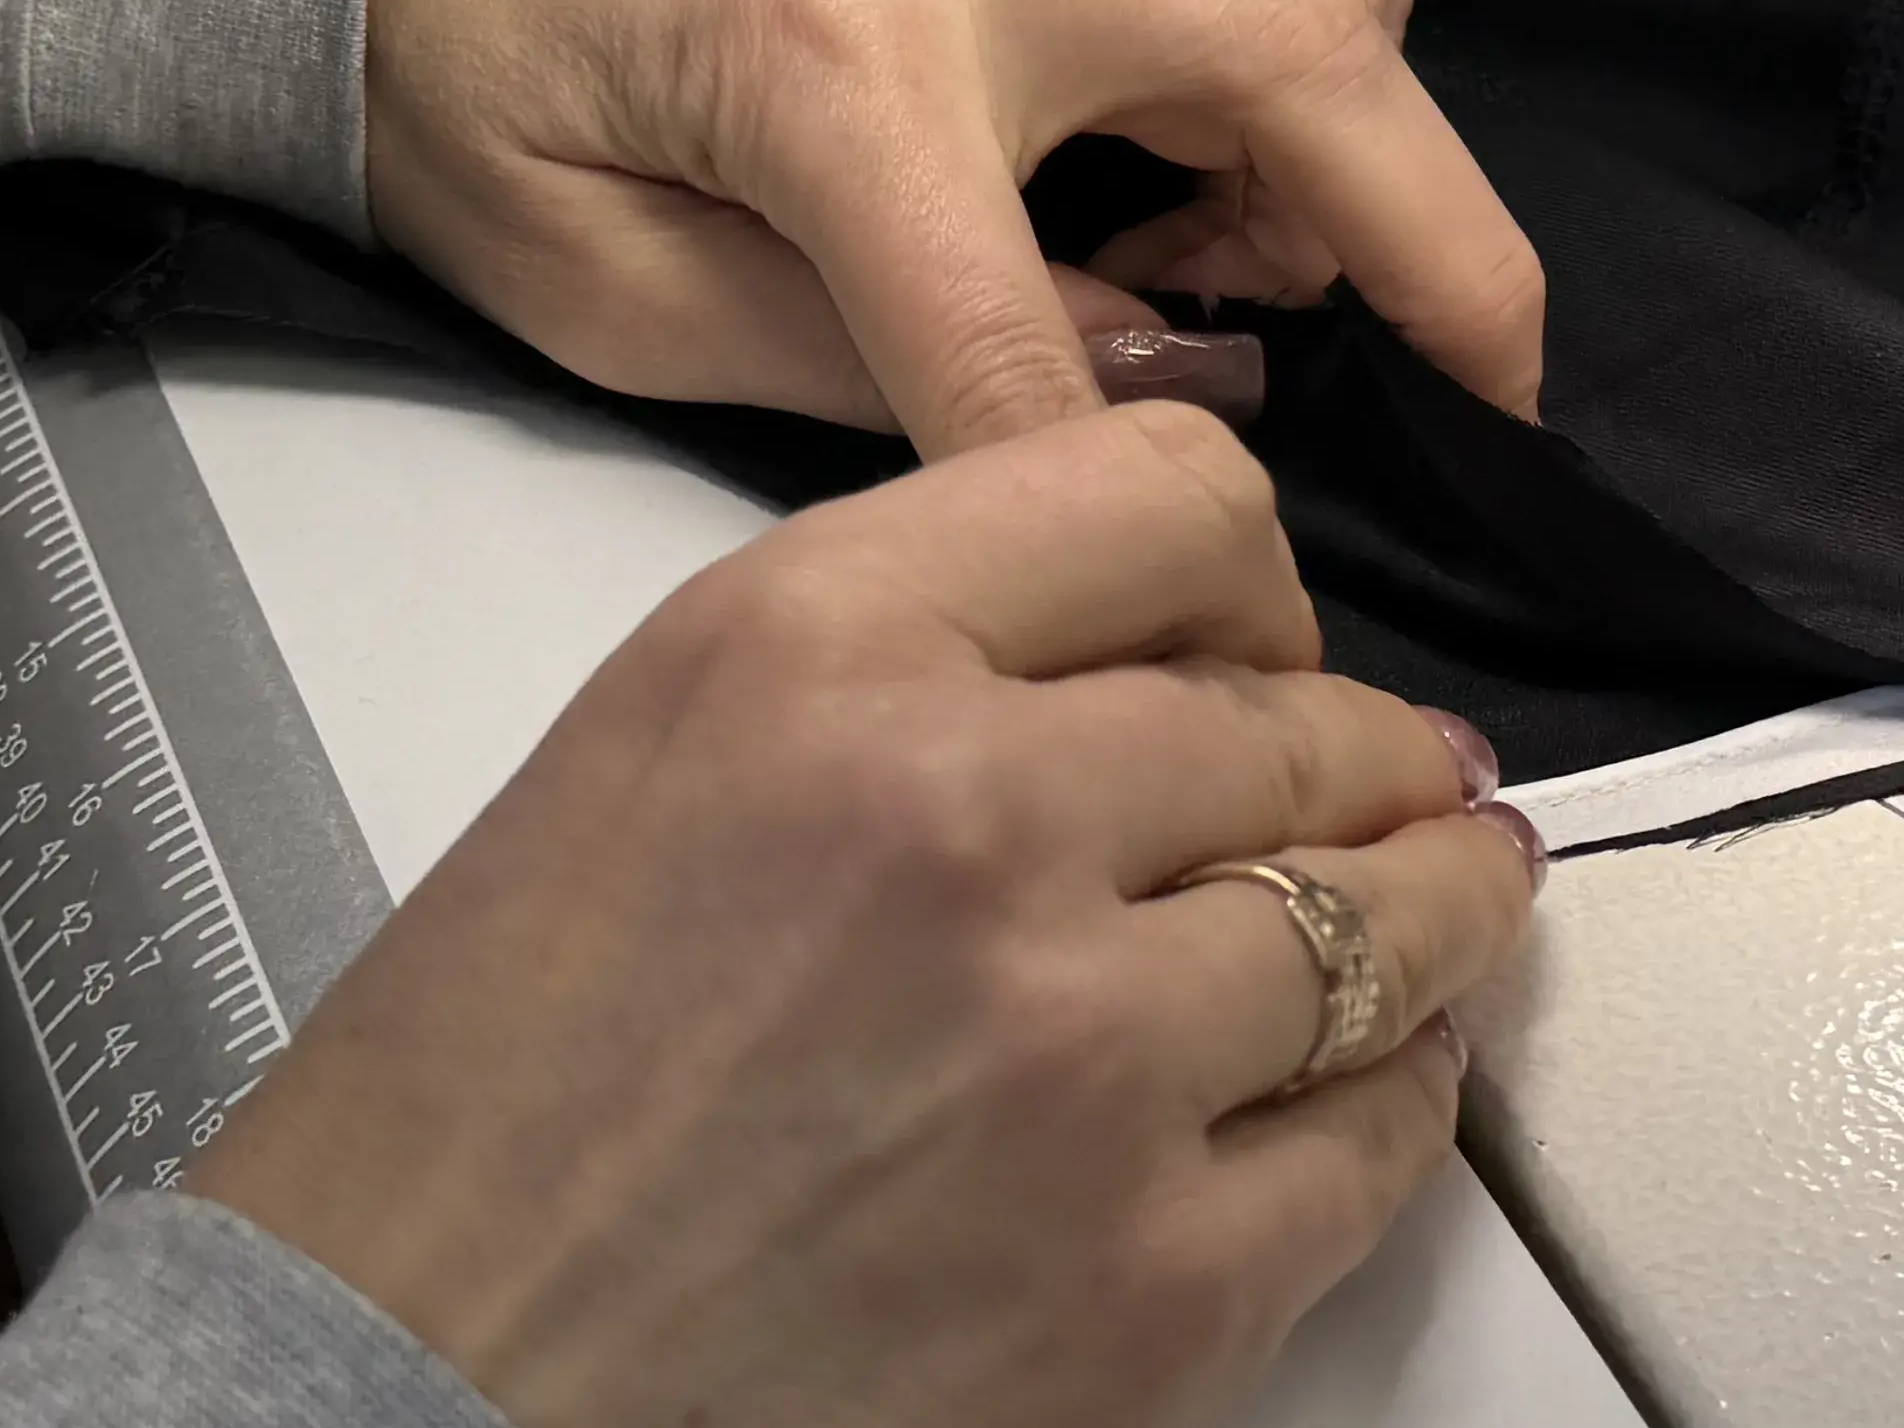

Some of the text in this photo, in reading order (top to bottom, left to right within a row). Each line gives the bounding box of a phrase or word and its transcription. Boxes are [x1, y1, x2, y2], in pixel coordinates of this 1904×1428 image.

[13, 641, 48, 683] 15
[16, 781, 47, 824] 40
[68, 782, 102, 827] 16
[37, 838, 71, 881] 41
[60, 900, 94, 946] 42
[124, 934, 162, 977] 17
[83, 960, 115, 1006] 43
[105, 1023, 140, 1070] 44
[127, 1089, 164, 1137] 45
[186, 1096, 224, 1148] 18
